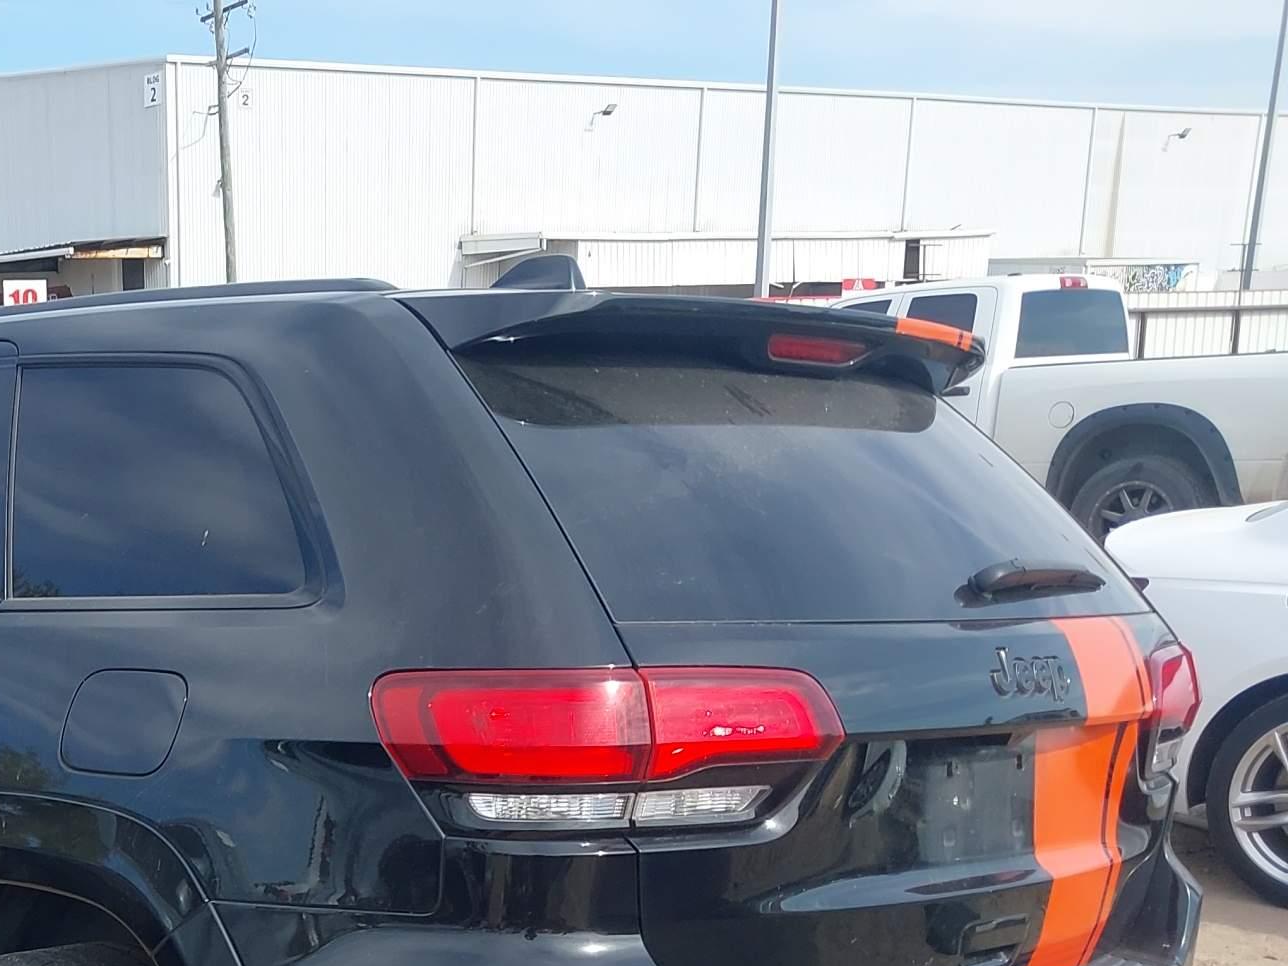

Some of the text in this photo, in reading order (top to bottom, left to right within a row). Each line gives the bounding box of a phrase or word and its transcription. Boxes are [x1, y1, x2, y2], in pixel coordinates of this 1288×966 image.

[150, 87, 157, 103] 2
[242, 94, 249, 106] 2
[989, 646, 1070, 704] Jeep
